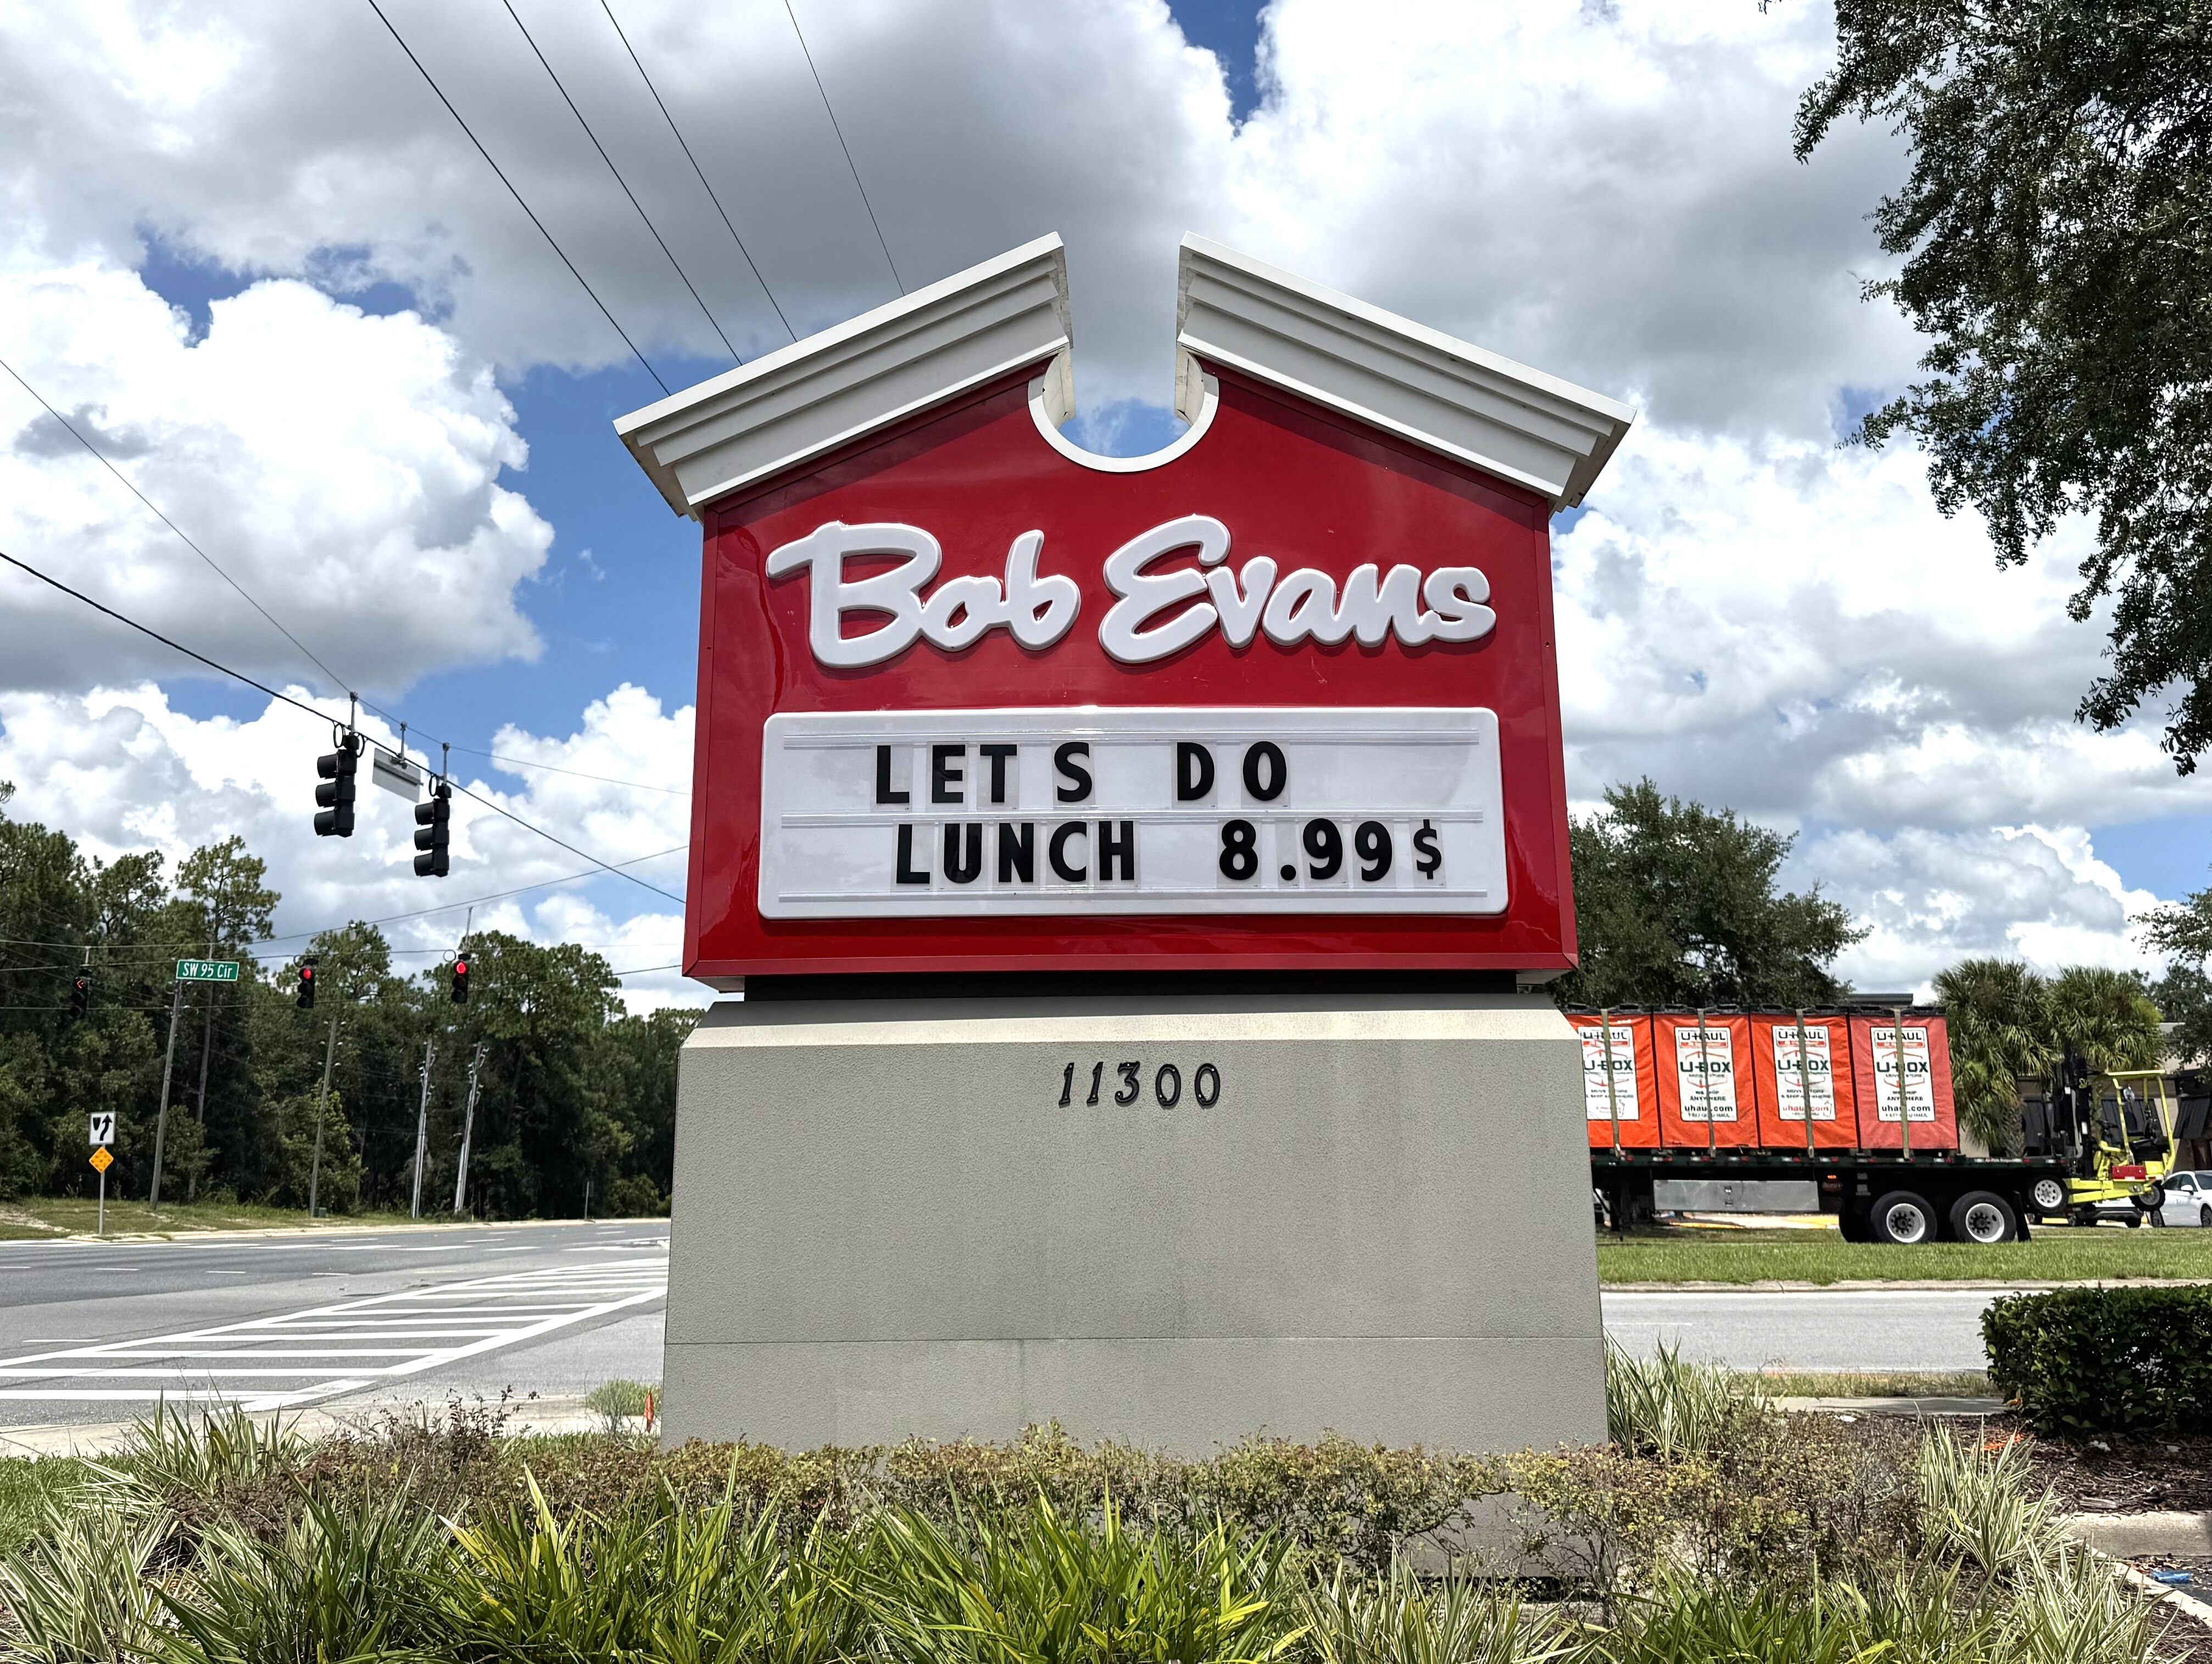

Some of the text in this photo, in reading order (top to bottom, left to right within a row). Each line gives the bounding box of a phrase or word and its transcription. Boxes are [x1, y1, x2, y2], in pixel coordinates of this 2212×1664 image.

[765, 513, 1496, 668] Bob Evans
[1177, 741, 1287, 801] DO
[896, 820, 1134, 884] LUNCH
[182, 962, 232, 978] SW 95 Cir
[1583, 1031, 1628, 1040] U-HUL
[1058, 1061, 1221, 1107] 11300
